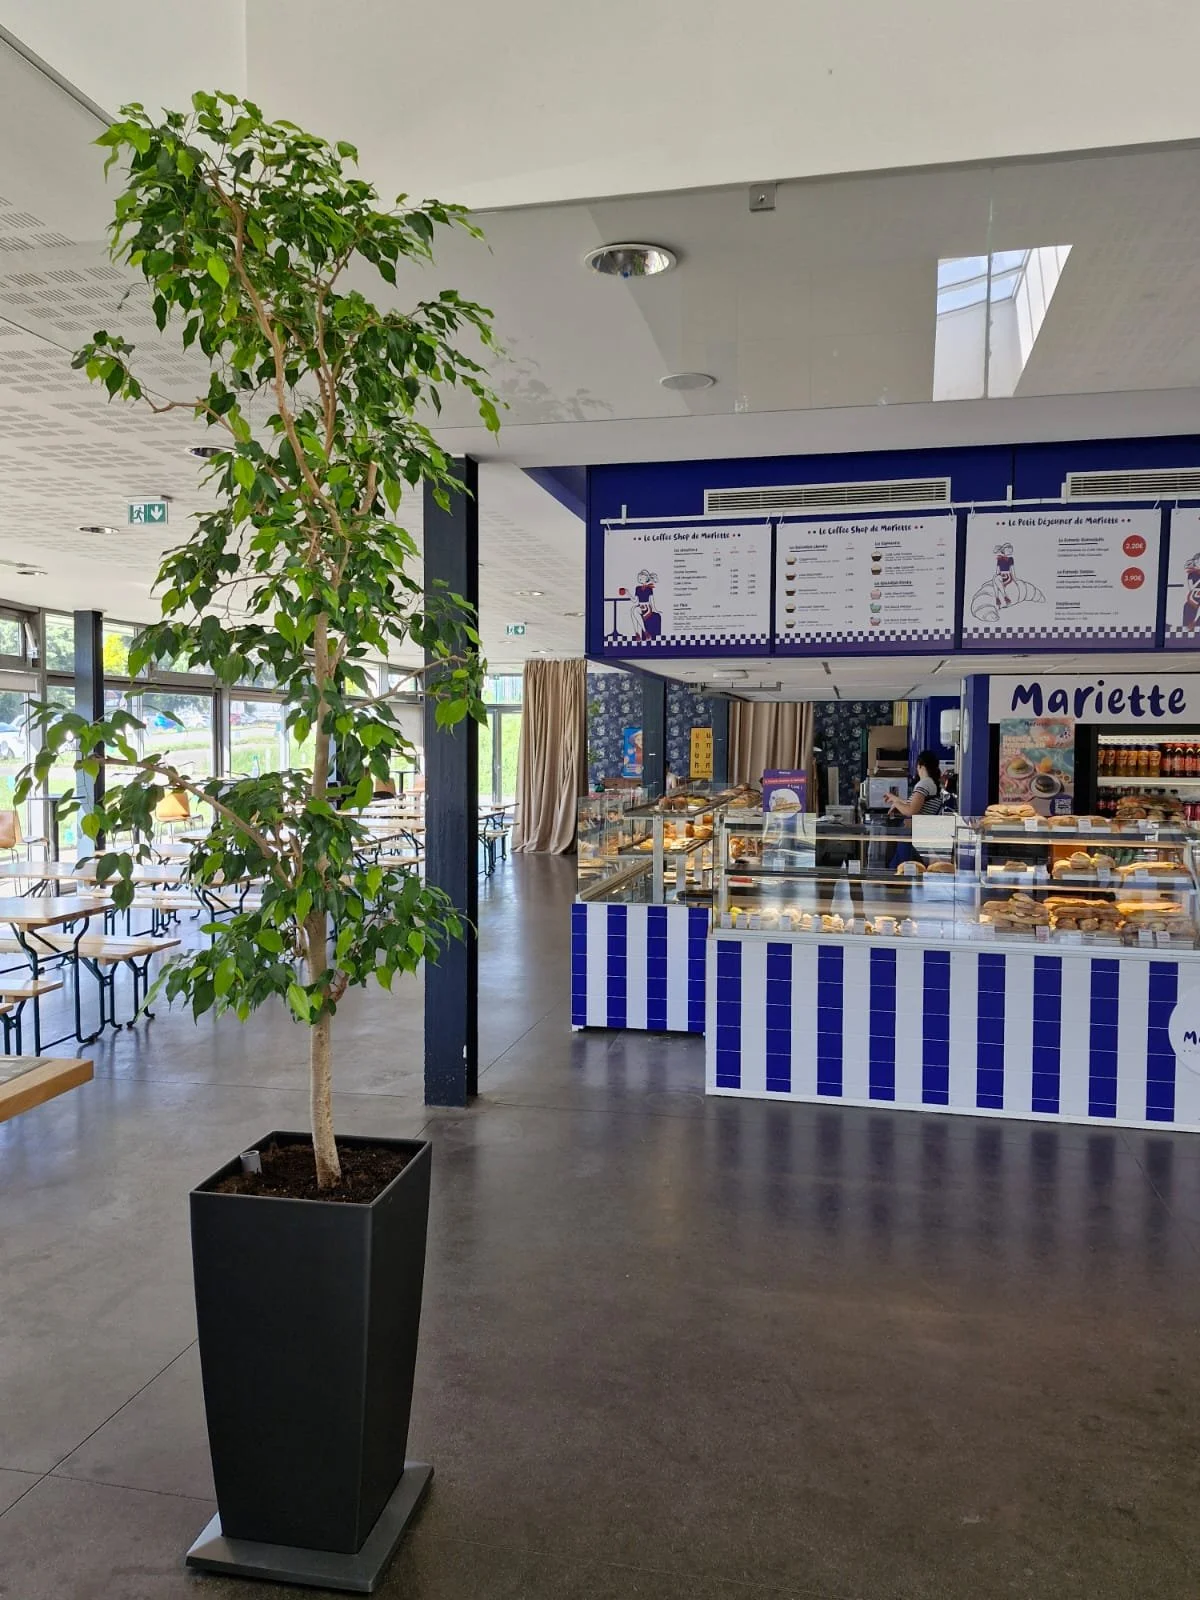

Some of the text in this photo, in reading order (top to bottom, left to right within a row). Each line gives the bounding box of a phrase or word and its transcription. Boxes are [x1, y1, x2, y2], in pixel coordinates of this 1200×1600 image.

[1018, 518, 1035, 526] Petit
[1074, 516, 1083, 525] de
[1086, 516, 1118, 525] Mariette
[819, 523, 911, 535] Le Coffee Shop de Mariette
[643, 531, 729, 542] Le Coffee Shop de Mariette
[1011, 679, 1186, 719] Mariette
[1183, 1030, 1200, 1046] M
